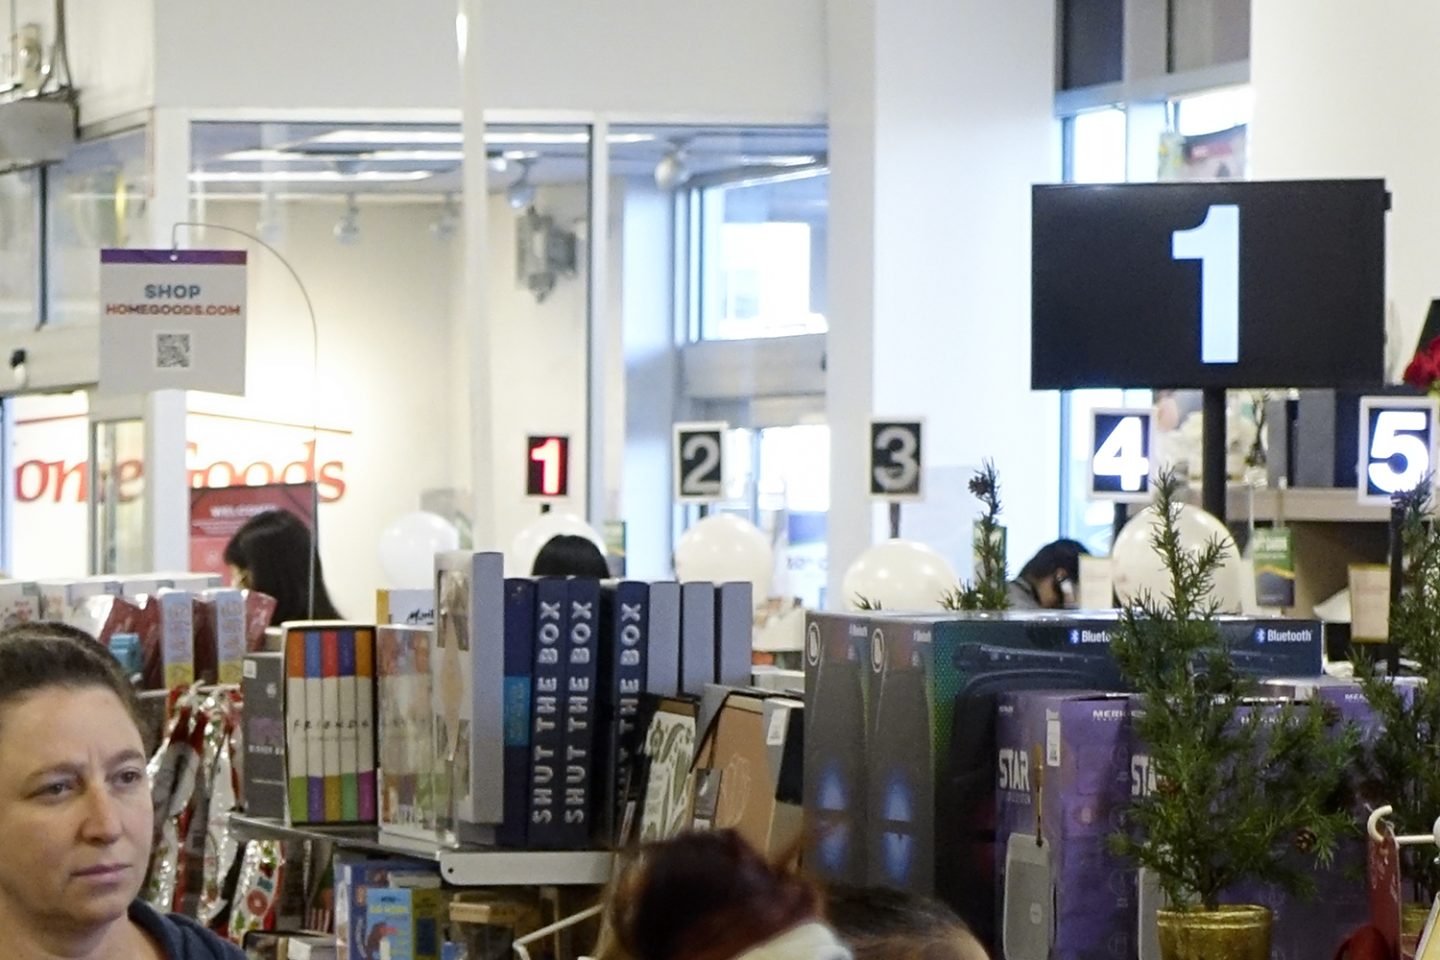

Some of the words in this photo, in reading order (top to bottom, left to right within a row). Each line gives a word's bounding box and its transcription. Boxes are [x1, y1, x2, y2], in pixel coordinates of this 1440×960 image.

[105, 303, 241, 317] HOMEGOODS.COM
[144, 284, 201, 299] SHOP
[1172, 204, 1240, 364] 1
[531, 438, 562, 495] 1
[682, 433, 721, 494] 2
[873, 425, 919, 491] 3
[1093, 416, 1149, 491] 4
[1367, 410, 1430, 494] 5
[537, 601, 561, 664] BOX
[570, 601, 592, 664] BOX
[620, 603, 642, 666] BOX
[1267, 629, 1312, 642] Bluetooth
[536, 677, 558, 733] THE
[568, 677, 590, 733] THE
[532, 745, 555, 824] SHUT
[565, 745, 587, 824] SHUT
[998, 748, 1030, 792] STAR
[1130, 754, 1159, 797] STA
